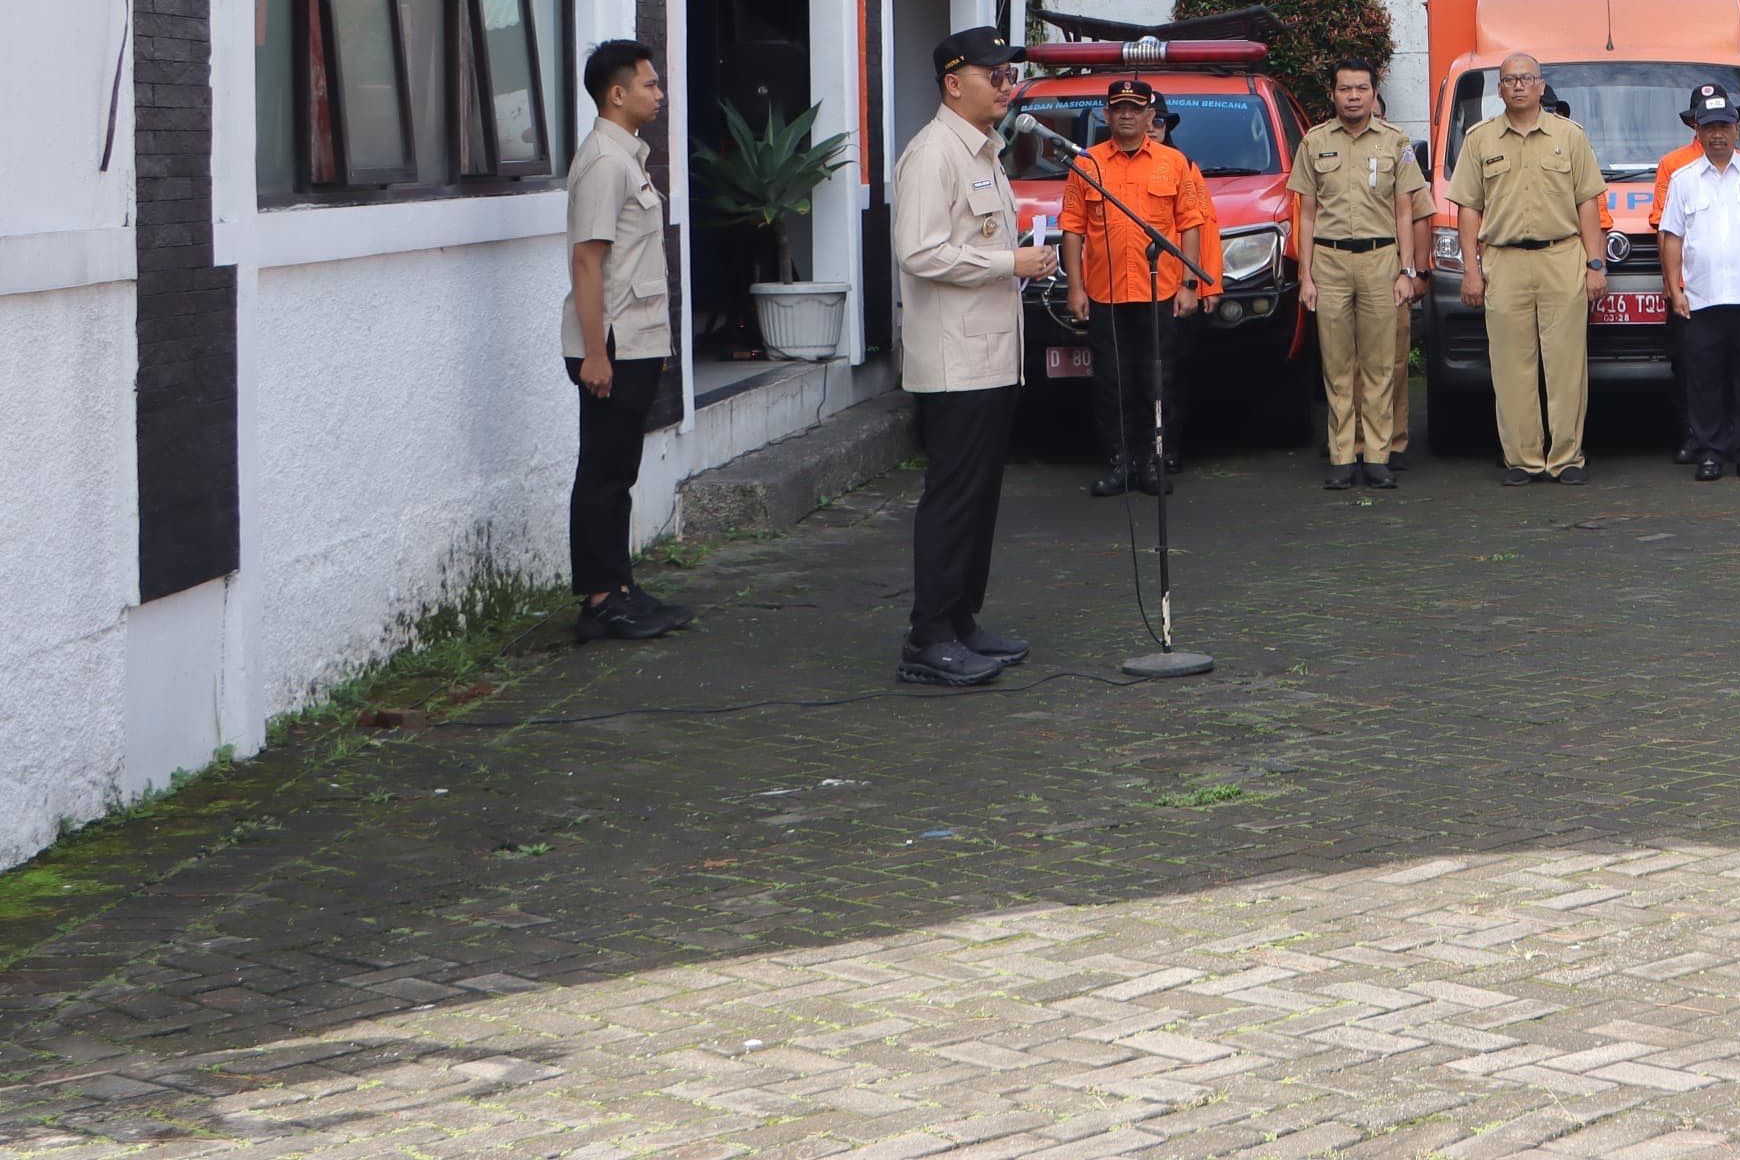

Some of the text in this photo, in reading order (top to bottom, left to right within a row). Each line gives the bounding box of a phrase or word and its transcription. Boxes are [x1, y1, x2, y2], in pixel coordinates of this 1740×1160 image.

[1020, 103, 1053, 112] BADAN
[1055, 100, 1104, 110] NASIONAL
[1201, 100, 1248, 110] BENCANA
[1051, 350, 1060, 367] D
